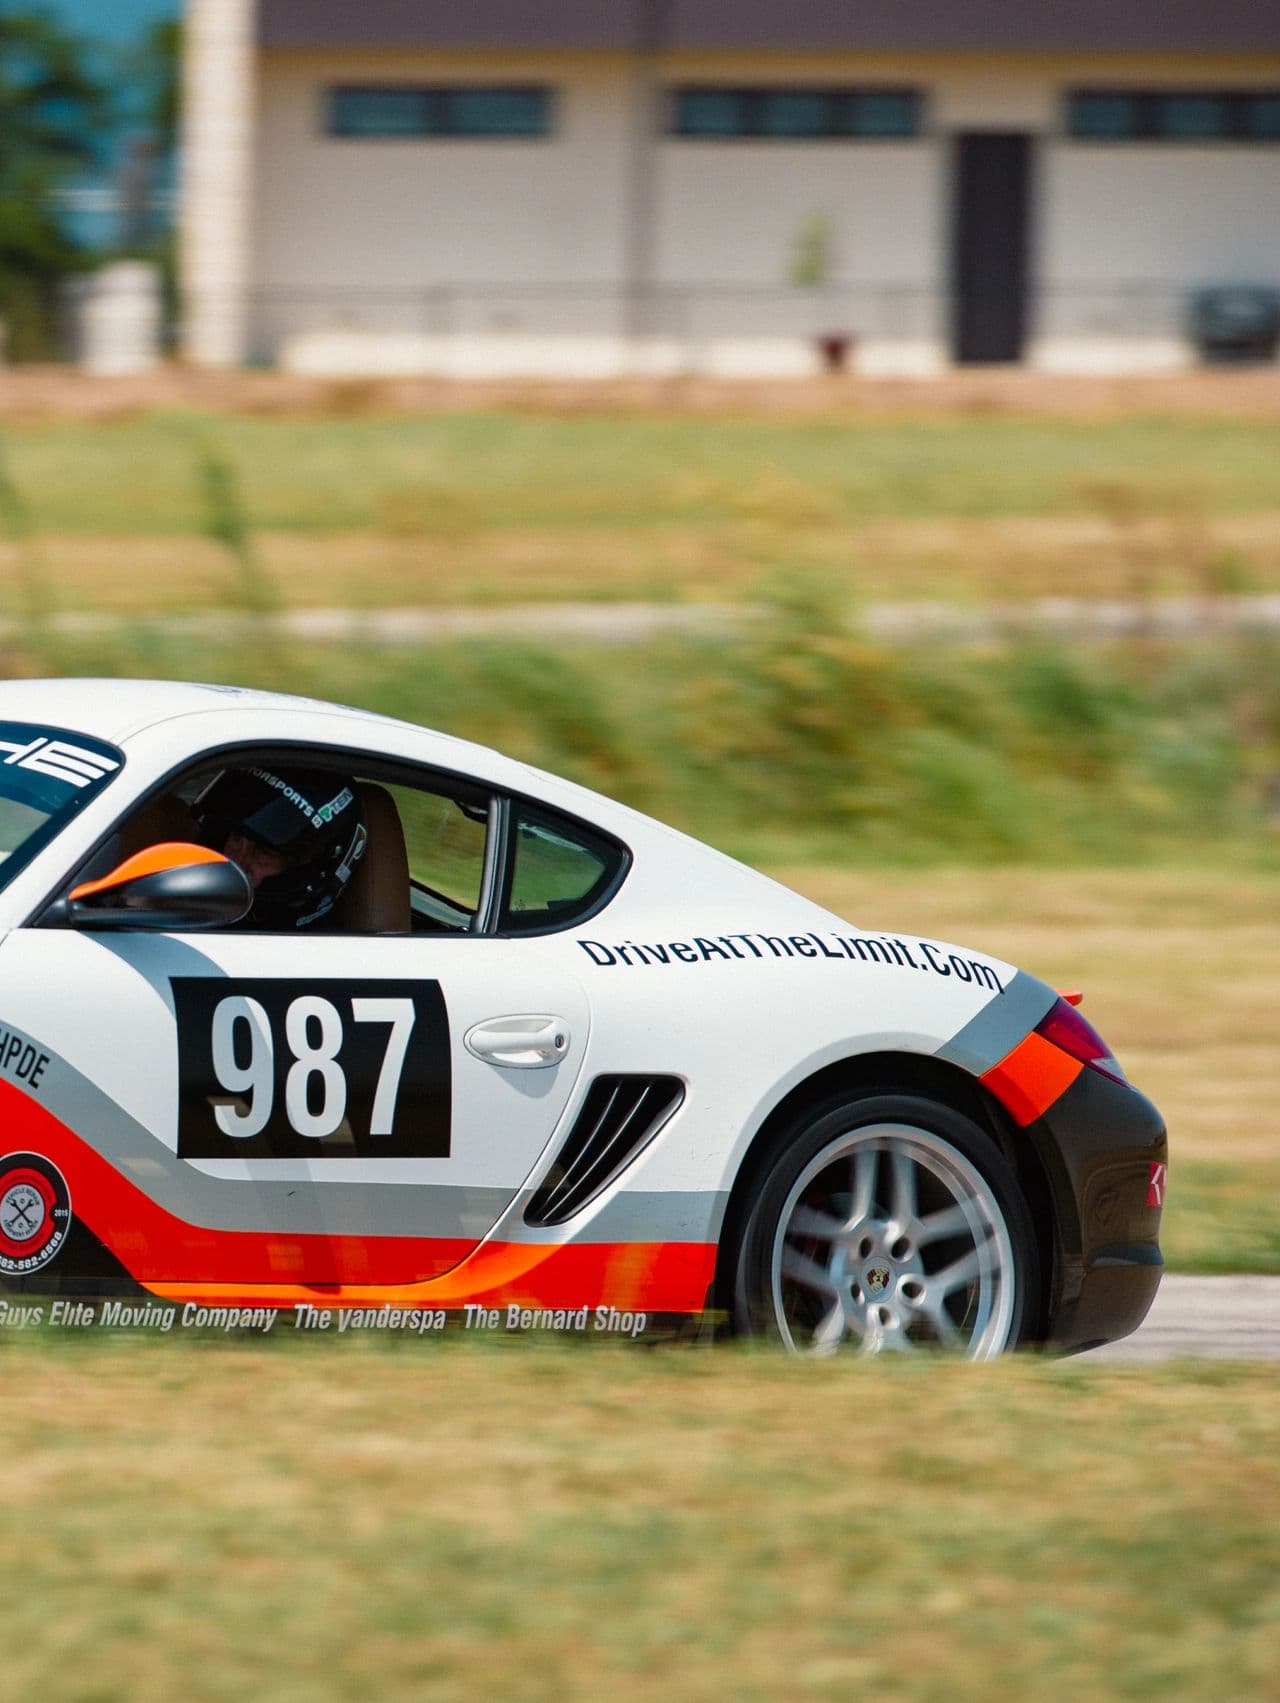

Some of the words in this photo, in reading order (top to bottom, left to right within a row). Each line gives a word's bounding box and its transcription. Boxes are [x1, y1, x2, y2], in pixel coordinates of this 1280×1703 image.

[577, 932, 1003, 994] DriveAtTheLimit.Com
[212, 995, 416, 1138] 987
[48, 1301, 95, 1326] Elite
[99, 1302, 175, 1332] Moving
[181, 1302, 278, 1332] Company
[294, 1304, 331, 1329] The
[463, 1304, 500, 1330] The
[505, 1304, 587, 1331] Bernard
[594, 1305, 647, 1337] Shop
